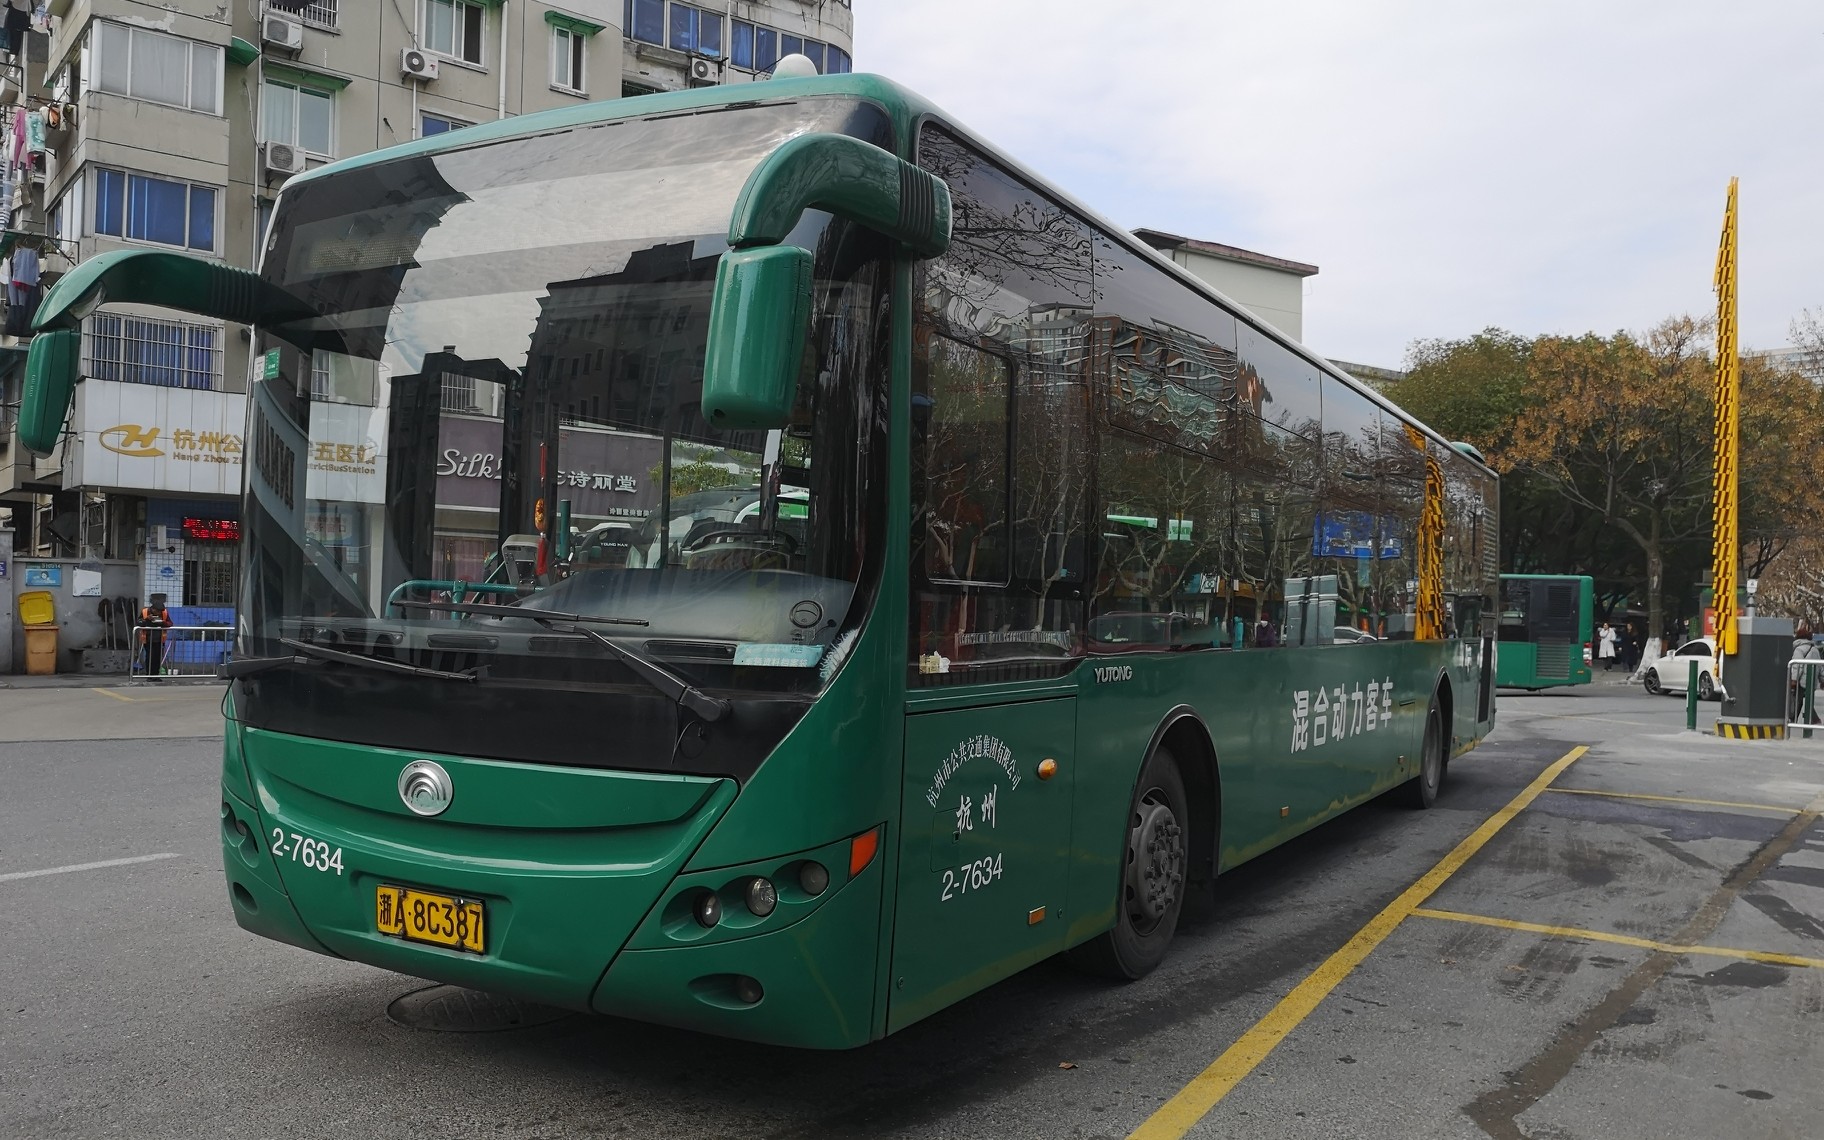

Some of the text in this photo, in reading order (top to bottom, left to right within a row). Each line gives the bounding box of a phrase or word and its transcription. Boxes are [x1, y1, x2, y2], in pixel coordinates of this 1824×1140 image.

[173, 452, 200, 462] Hang
[204, 455, 229, 464] Zhou
[308, 463, 376, 474] trictBusStation
[174, 428, 243, 453] 杭州公
[1095, 666, 1133, 683] YUTONG
[1291, 676, 1394, 754] 混合动力客车
[926, 735, 1021, 808] 杭州市公共交通集团有限公司
[956, 784, 997, 833] 杭州
[272, 827, 344, 876] 2-7634
[941, 852, 1003, 902] 2-7634
